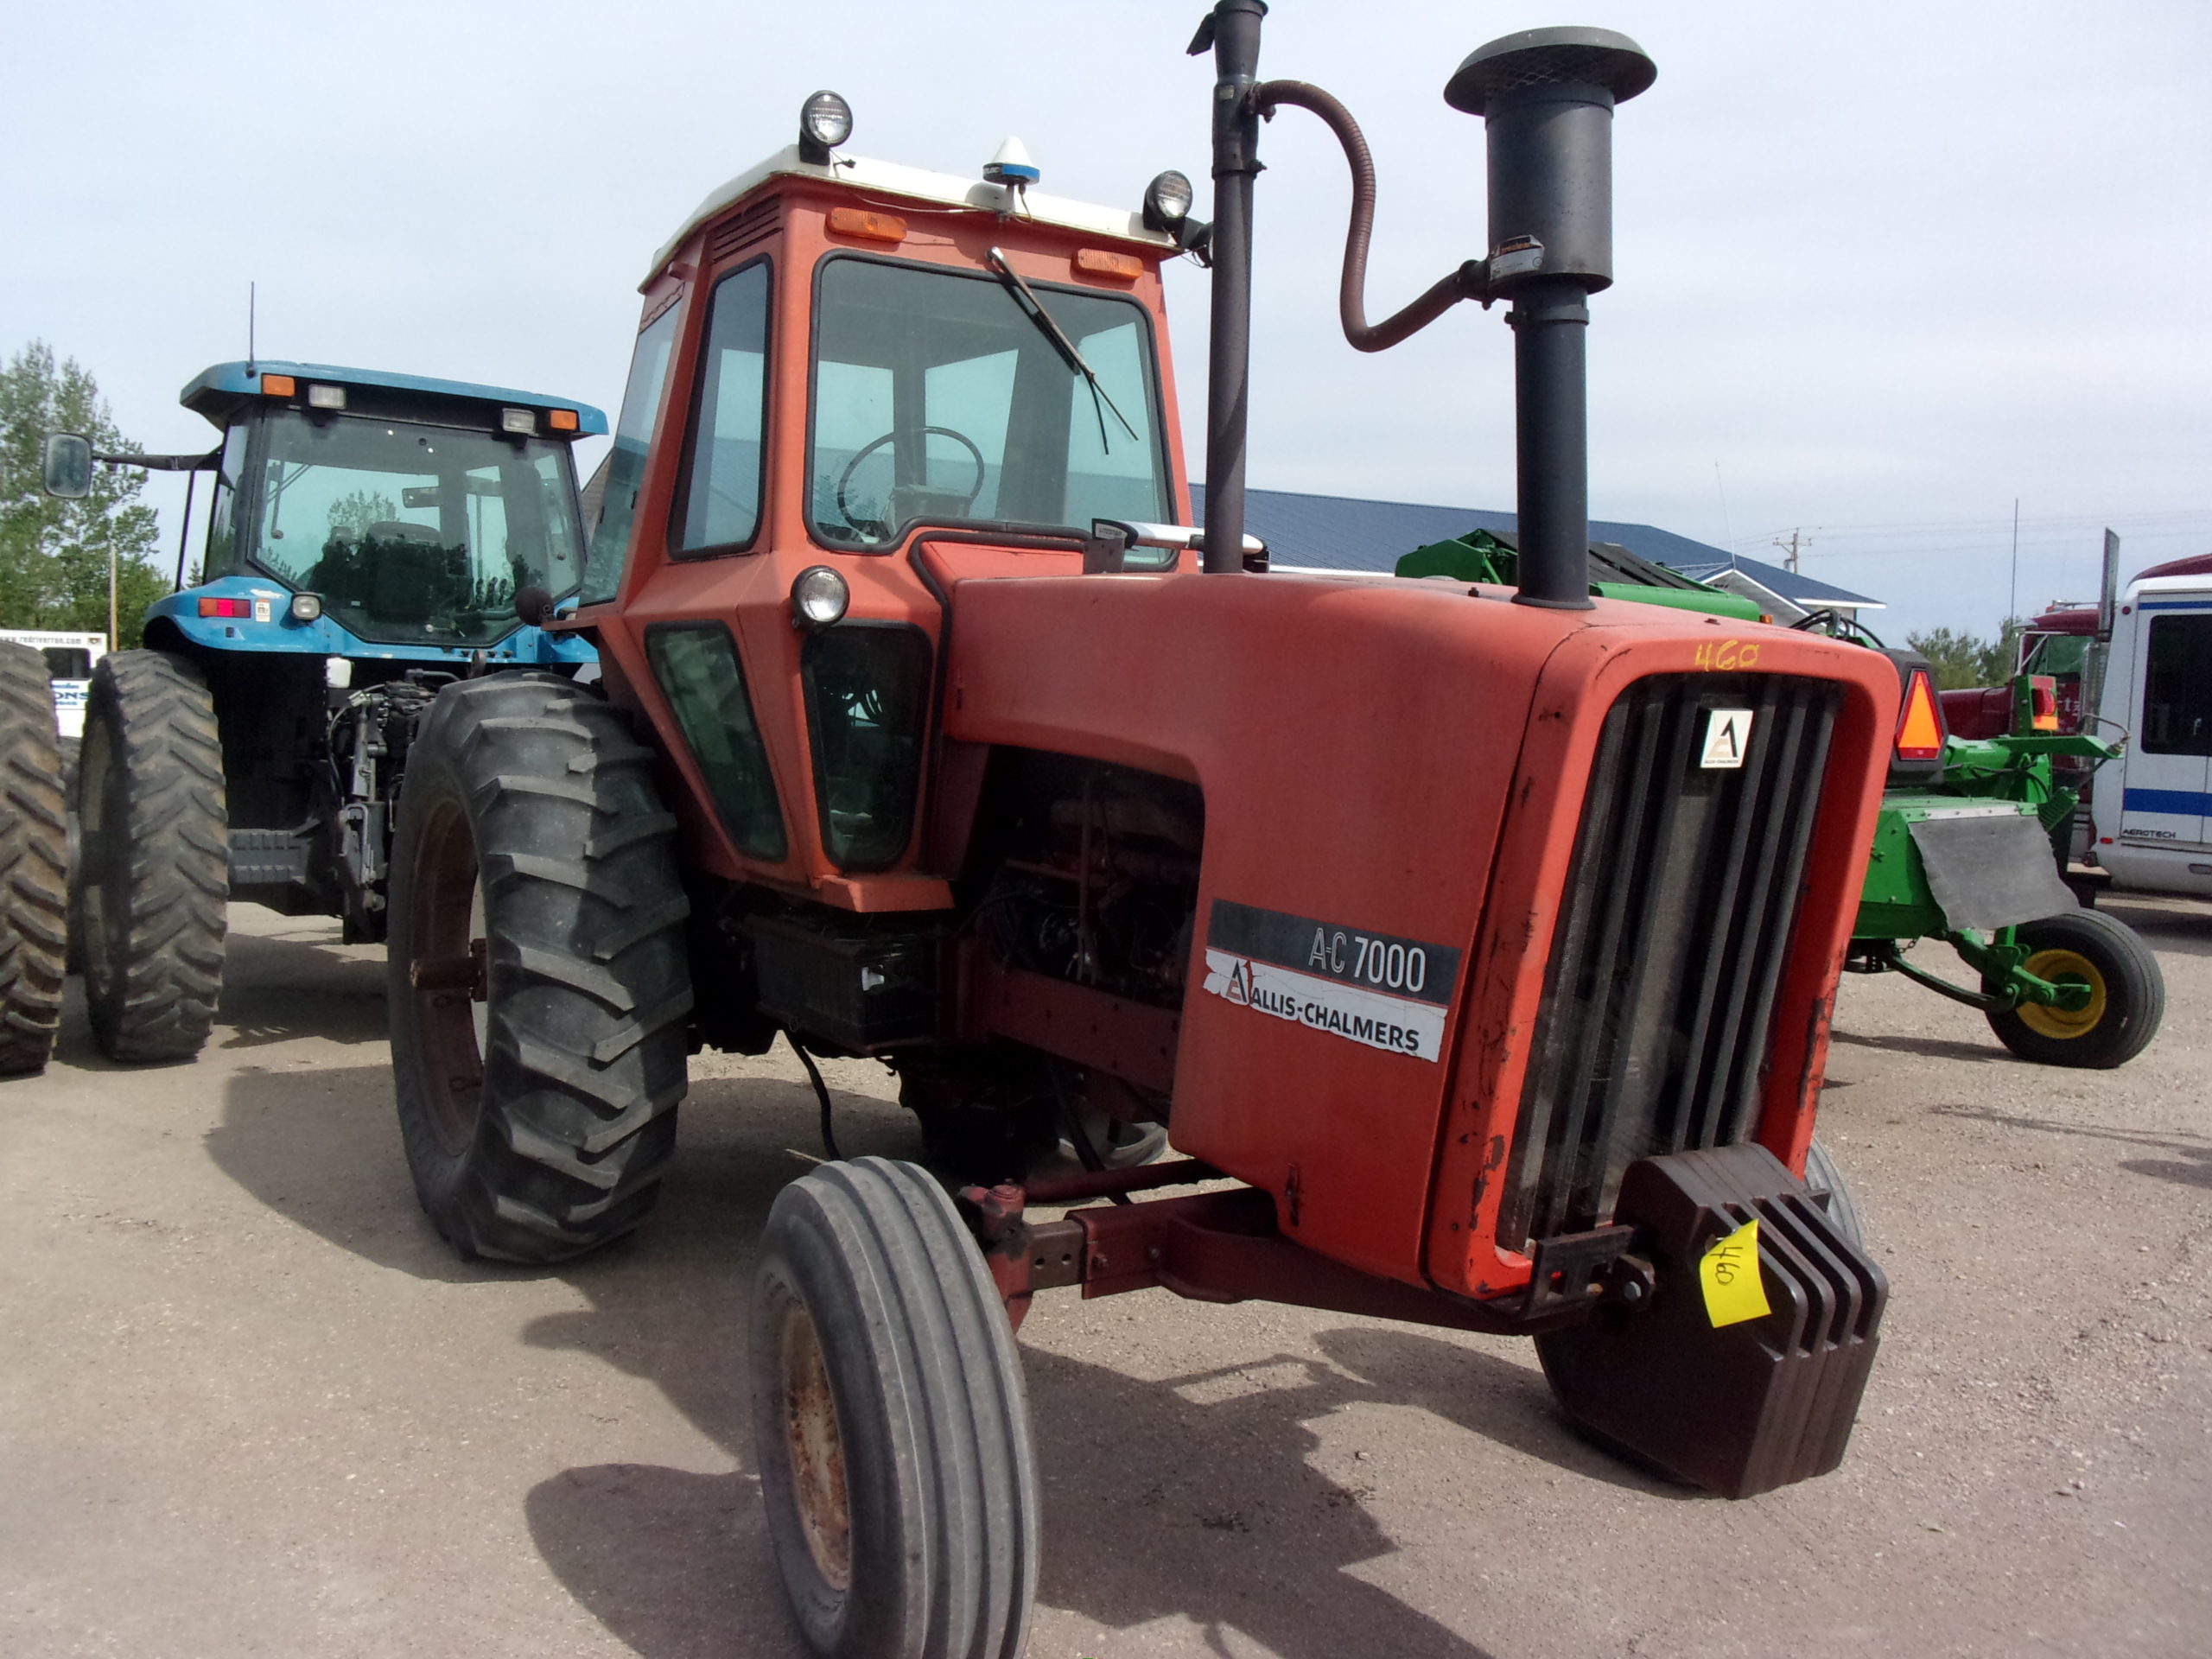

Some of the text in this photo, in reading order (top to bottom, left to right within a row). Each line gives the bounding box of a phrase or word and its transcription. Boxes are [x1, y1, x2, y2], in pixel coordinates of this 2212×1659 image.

[1694, 639, 1760, 671] 460
[2122, 829, 2177, 838] AEROTECH
[1354, 937, 1426, 993] 7000
[1251, 987, 1420, 1052] ALLIS-CHALMERS
[1710, 1246, 1744, 1286] 460
